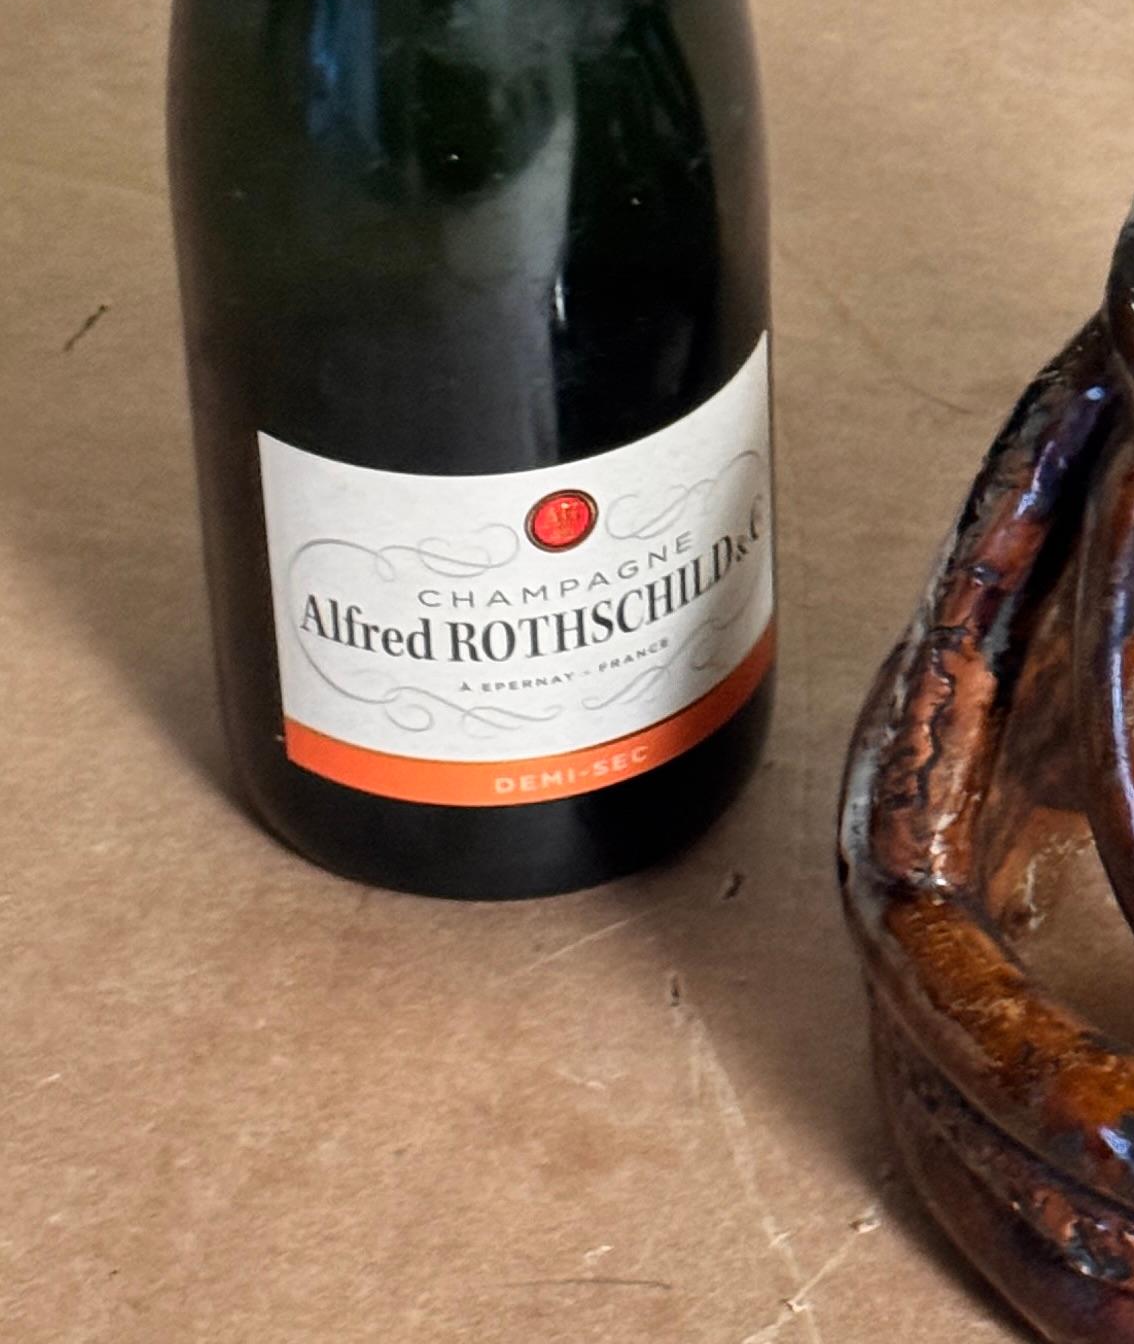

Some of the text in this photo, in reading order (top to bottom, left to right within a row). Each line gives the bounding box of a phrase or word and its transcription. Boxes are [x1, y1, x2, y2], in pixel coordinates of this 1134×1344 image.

[417, 530, 693, 609] CHAMPAGNE
[299, 593, 438, 661] Alfred
[481, 671, 575, 692] EPERNAY
[598, 637, 669, 673] FRANCE
[494, 745, 648, 794] DEMI-SEC
